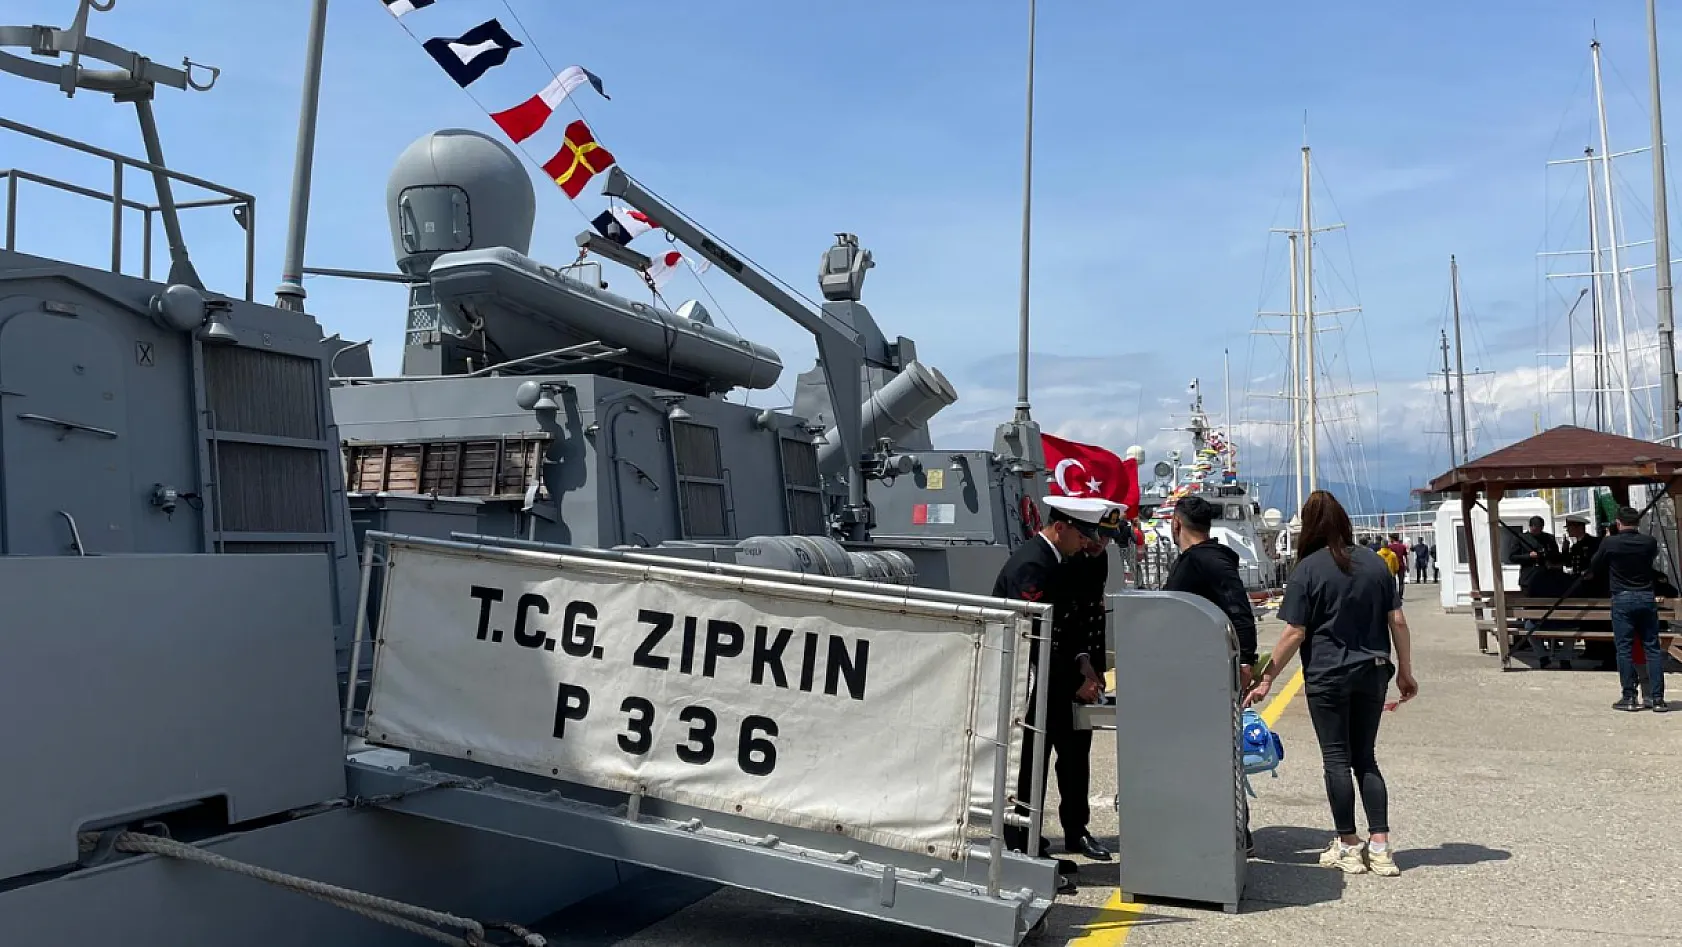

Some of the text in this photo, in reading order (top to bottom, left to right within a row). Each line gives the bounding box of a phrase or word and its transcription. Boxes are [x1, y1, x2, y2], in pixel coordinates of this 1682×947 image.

[470, 584, 871, 701] T.C.G. ZIPKIN
[552, 682, 779, 777] P 336
